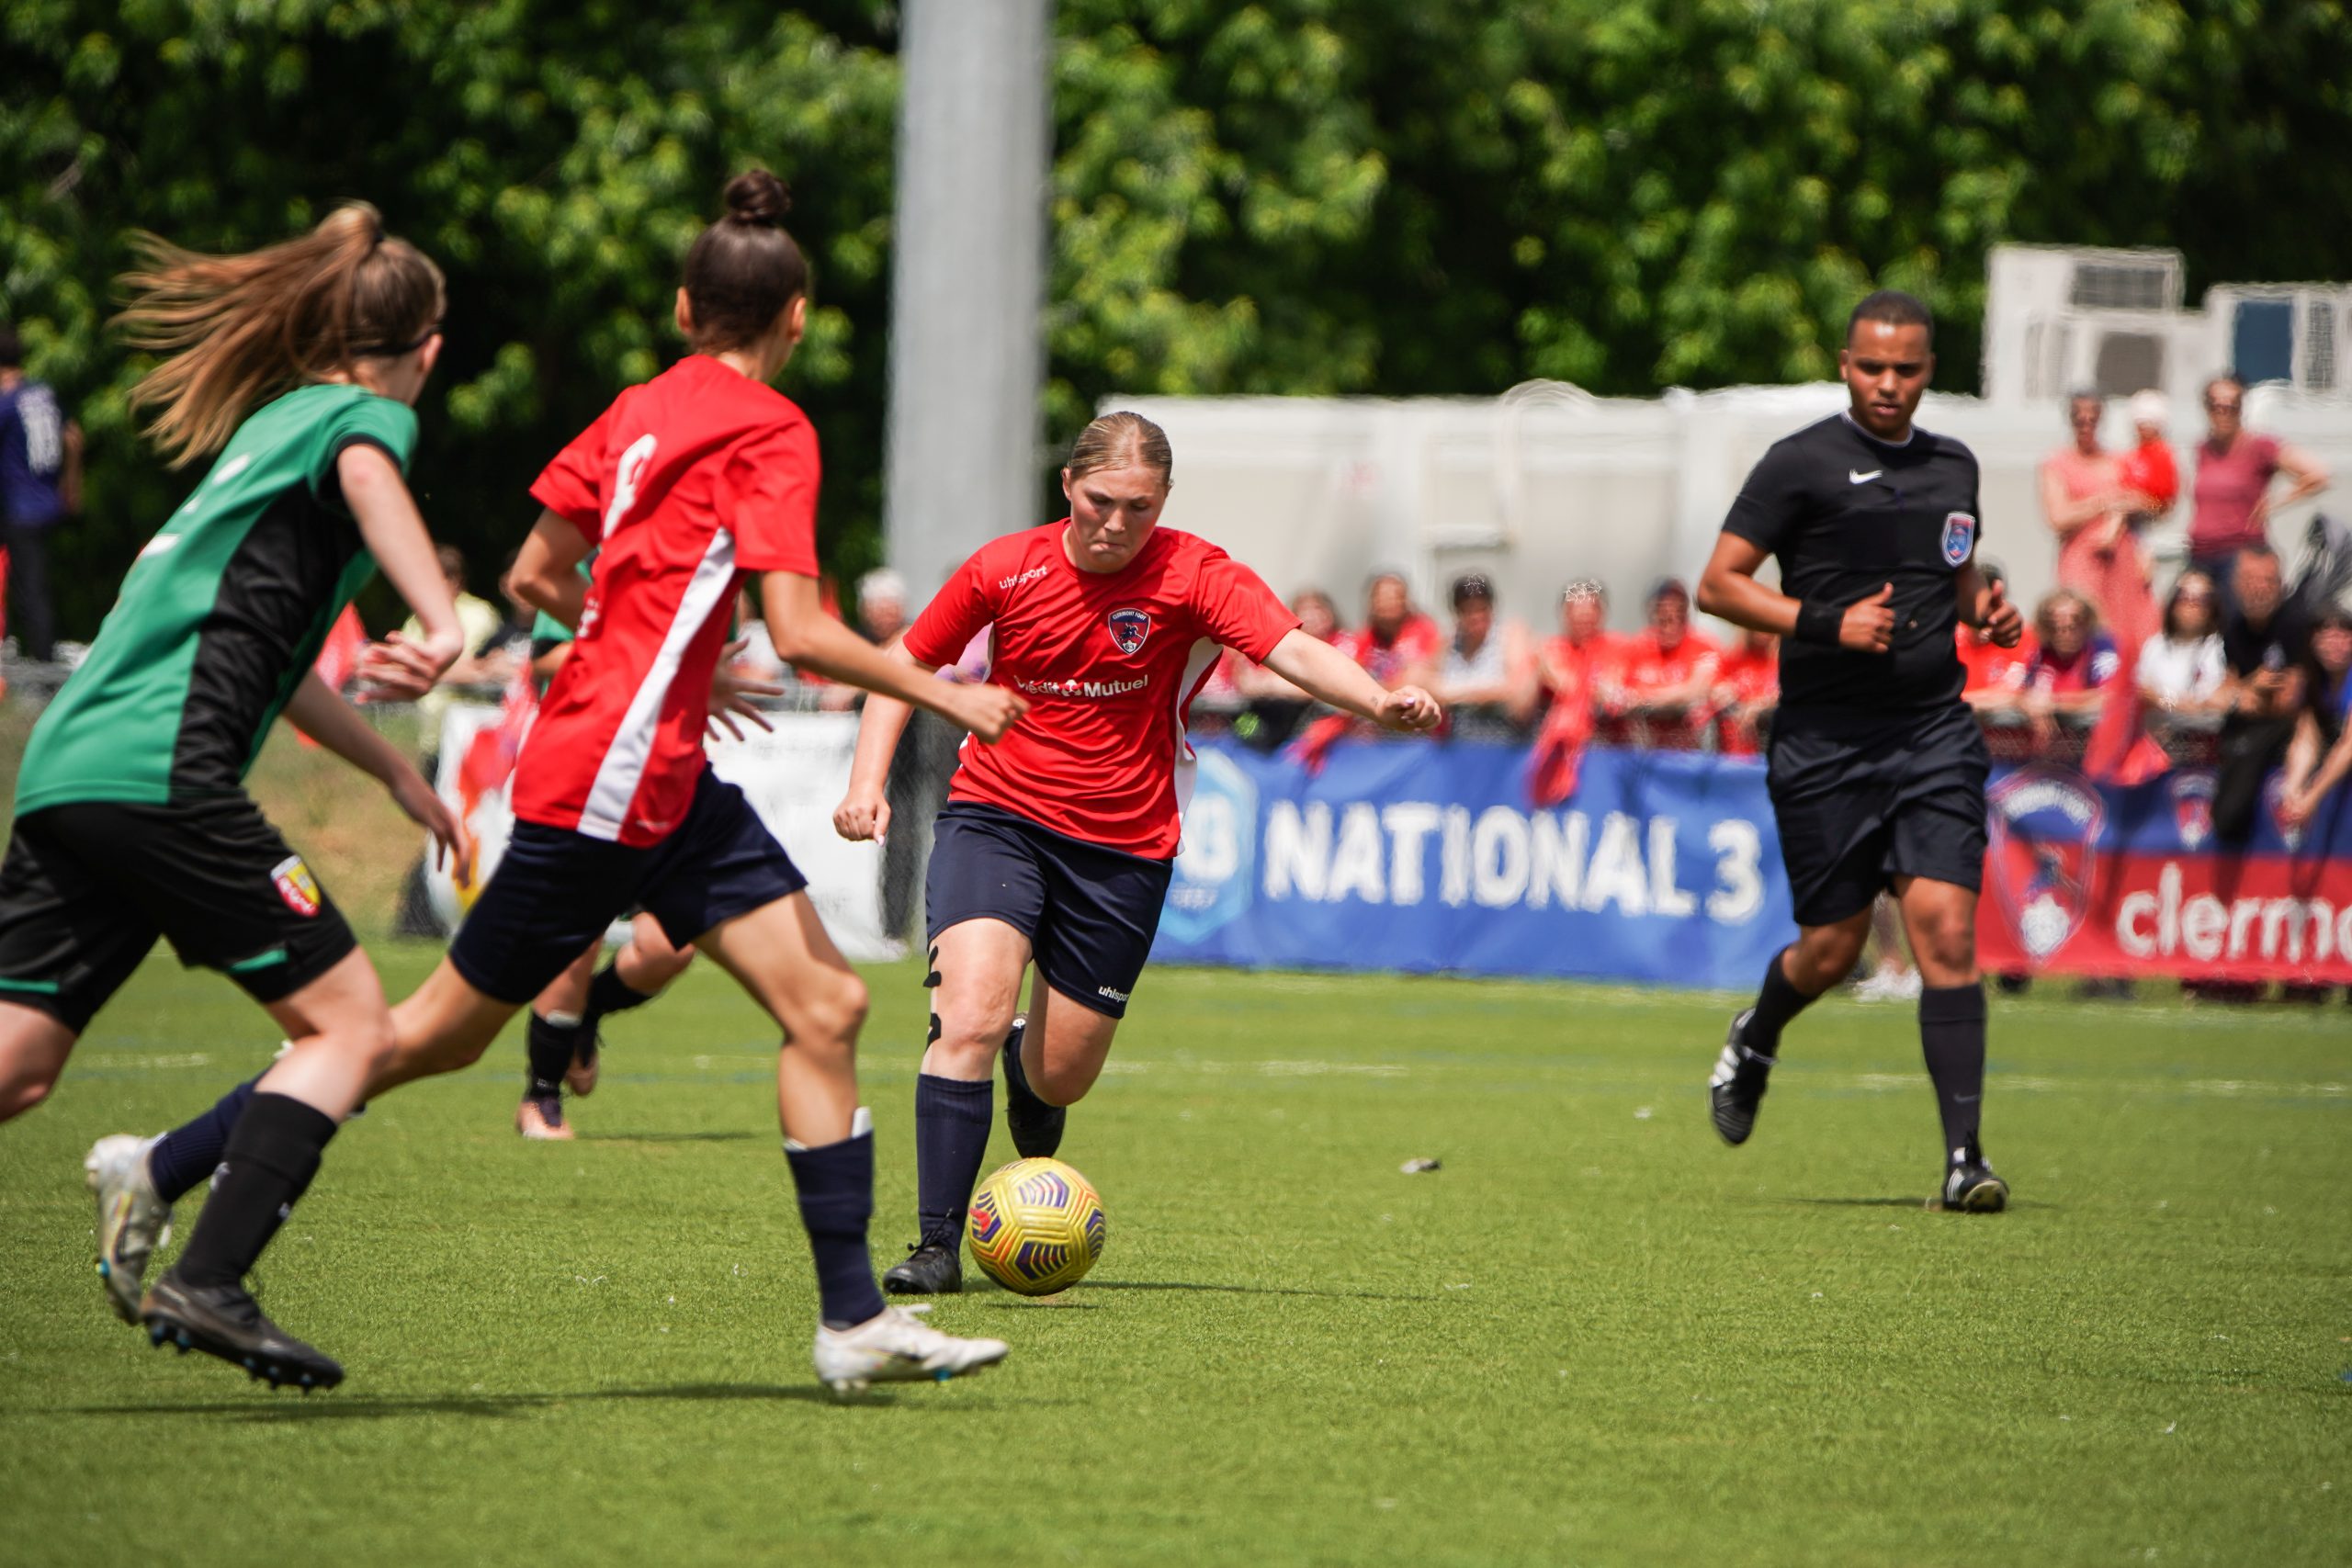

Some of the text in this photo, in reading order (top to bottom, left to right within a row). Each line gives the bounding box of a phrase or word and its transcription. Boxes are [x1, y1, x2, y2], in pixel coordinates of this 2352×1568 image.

[999, 565, 1047, 589] uhlsport
[1084, 674, 1148, 697] Mutuel
[1264, 800, 1697, 918] NATIONAL
[1706, 818, 1766, 926] 3
